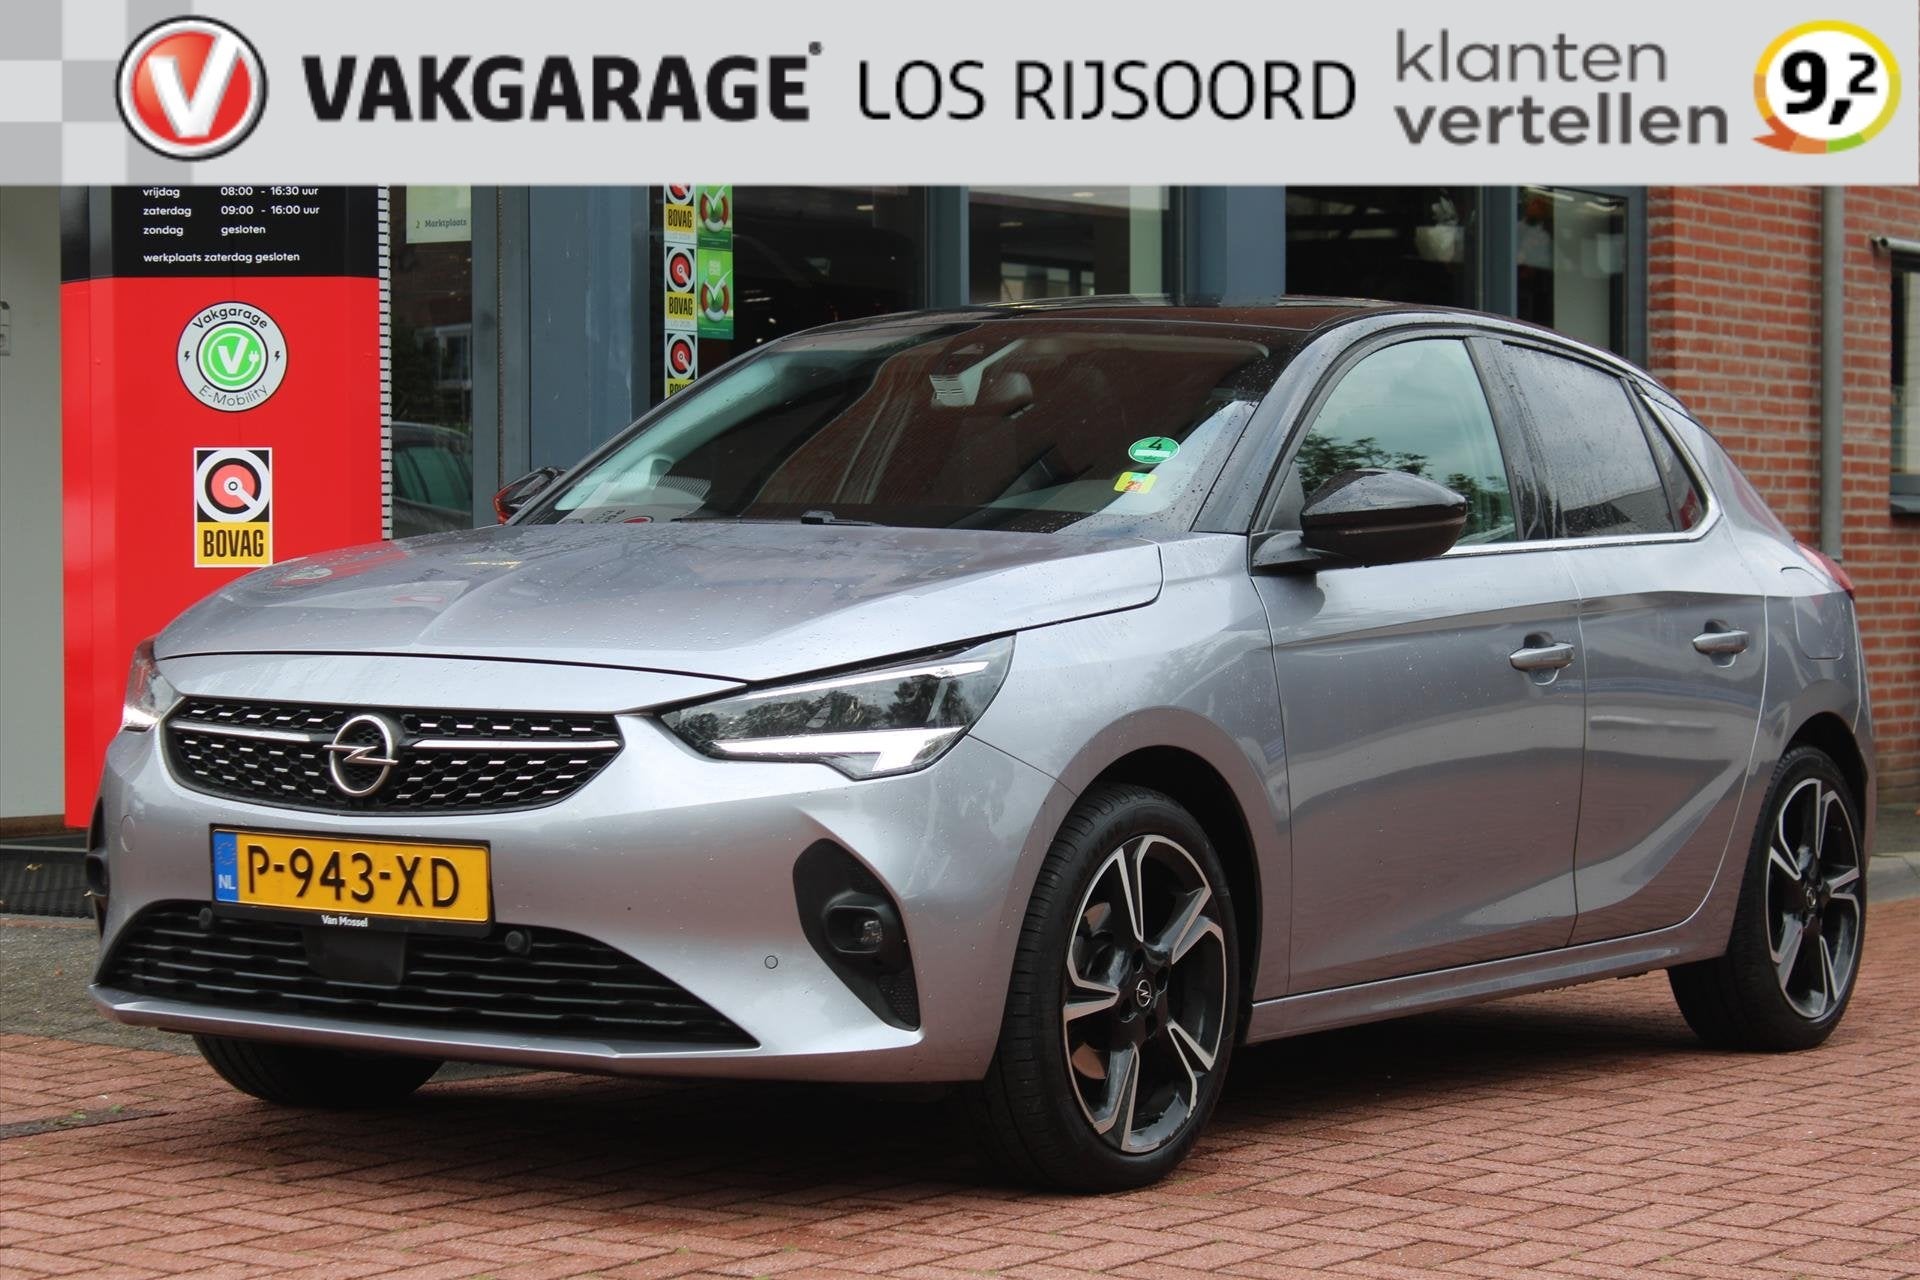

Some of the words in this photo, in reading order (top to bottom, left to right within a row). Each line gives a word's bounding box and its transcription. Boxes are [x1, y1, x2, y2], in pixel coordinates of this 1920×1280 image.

[142, 187, 181, 199] vrijdag
[220, 186, 254, 196] 08:00
[270, 186, 300, 196] 16:30
[301, 187, 319, 196] uur
[143, 206, 192, 217] zaterdag
[220, 205, 254, 215] 09:00
[270, 205, 301, 215] 16:00
[303, 206, 320, 215] uur
[667, 208, 693, 229] BOVAG
[143, 225, 184, 237] zondag
[220, 225, 266, 236] gesloten
[143, 253, 202, 264] werkplaats
[204, 253, 252, 264] zaterdag
[255, 252, 300, 264] gesloten
[668, 296, 693, 317] BOVAG
[192, 307, 268, 330] Vakgarage
[198, 384, 268, 408] E-Mobility
[203, 529, 265, 558] BOVAG
[218, 874, 237, 891] NL
[247, 844, 460, 908] P-943-XD
[321, 914, 338, 925] Van
[338, 916, 368, 928] Mossel
